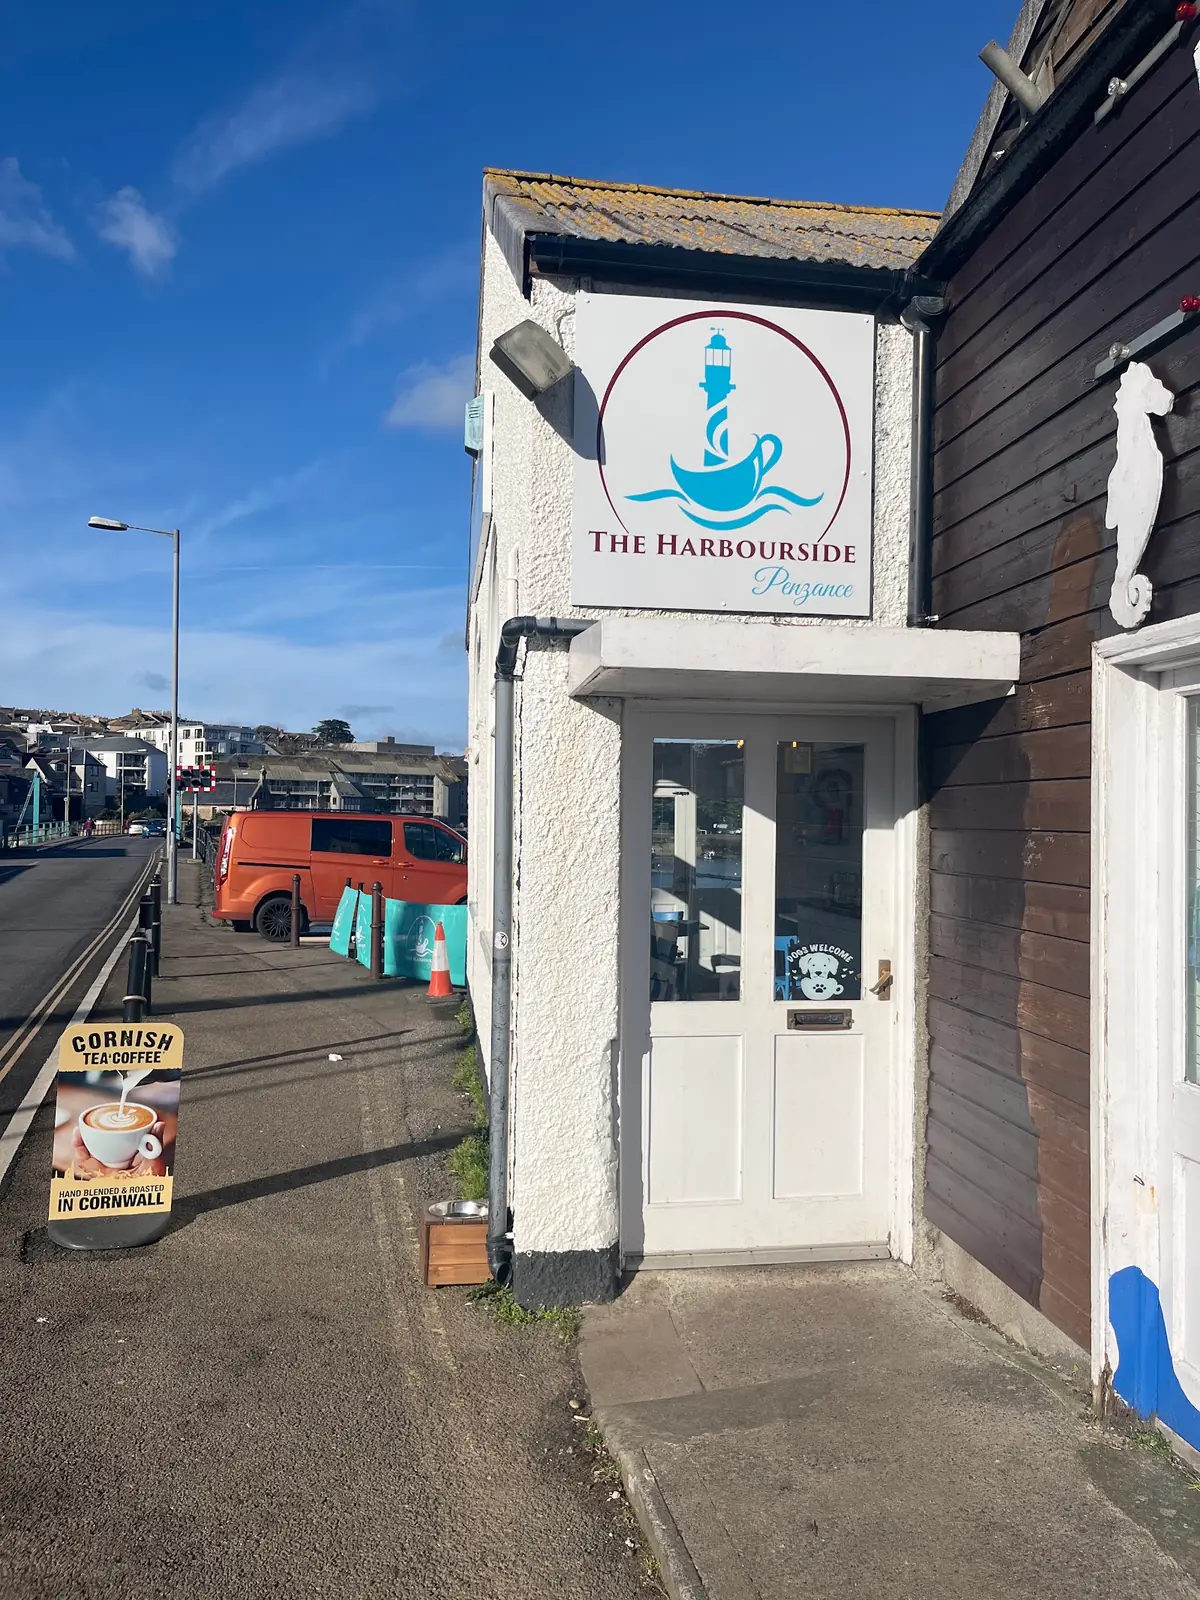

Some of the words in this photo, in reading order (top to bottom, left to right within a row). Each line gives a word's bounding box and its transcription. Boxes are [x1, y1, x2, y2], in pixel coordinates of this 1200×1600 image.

[588, 530, 646, 554] THE
[656, 533, 856, 563] HARBOURSIDE
[751, 565, 853, 605] Penzance
[786, 946, 809, 963] DOGS
[809, 943, 854, 963] WELCOME
[72, 1030, 174, 1053] CORNISH
[59, 1189, 81, 1198] HAND
[83, 1187, 119, 1196] BLENDED
[121, 1186, 128, 1194] &
[129, 1184, 165, 1192] ROASTED
[57, 1198, 74, 1212] IN
[79, 1192, 165, 1211] CORNWALL
